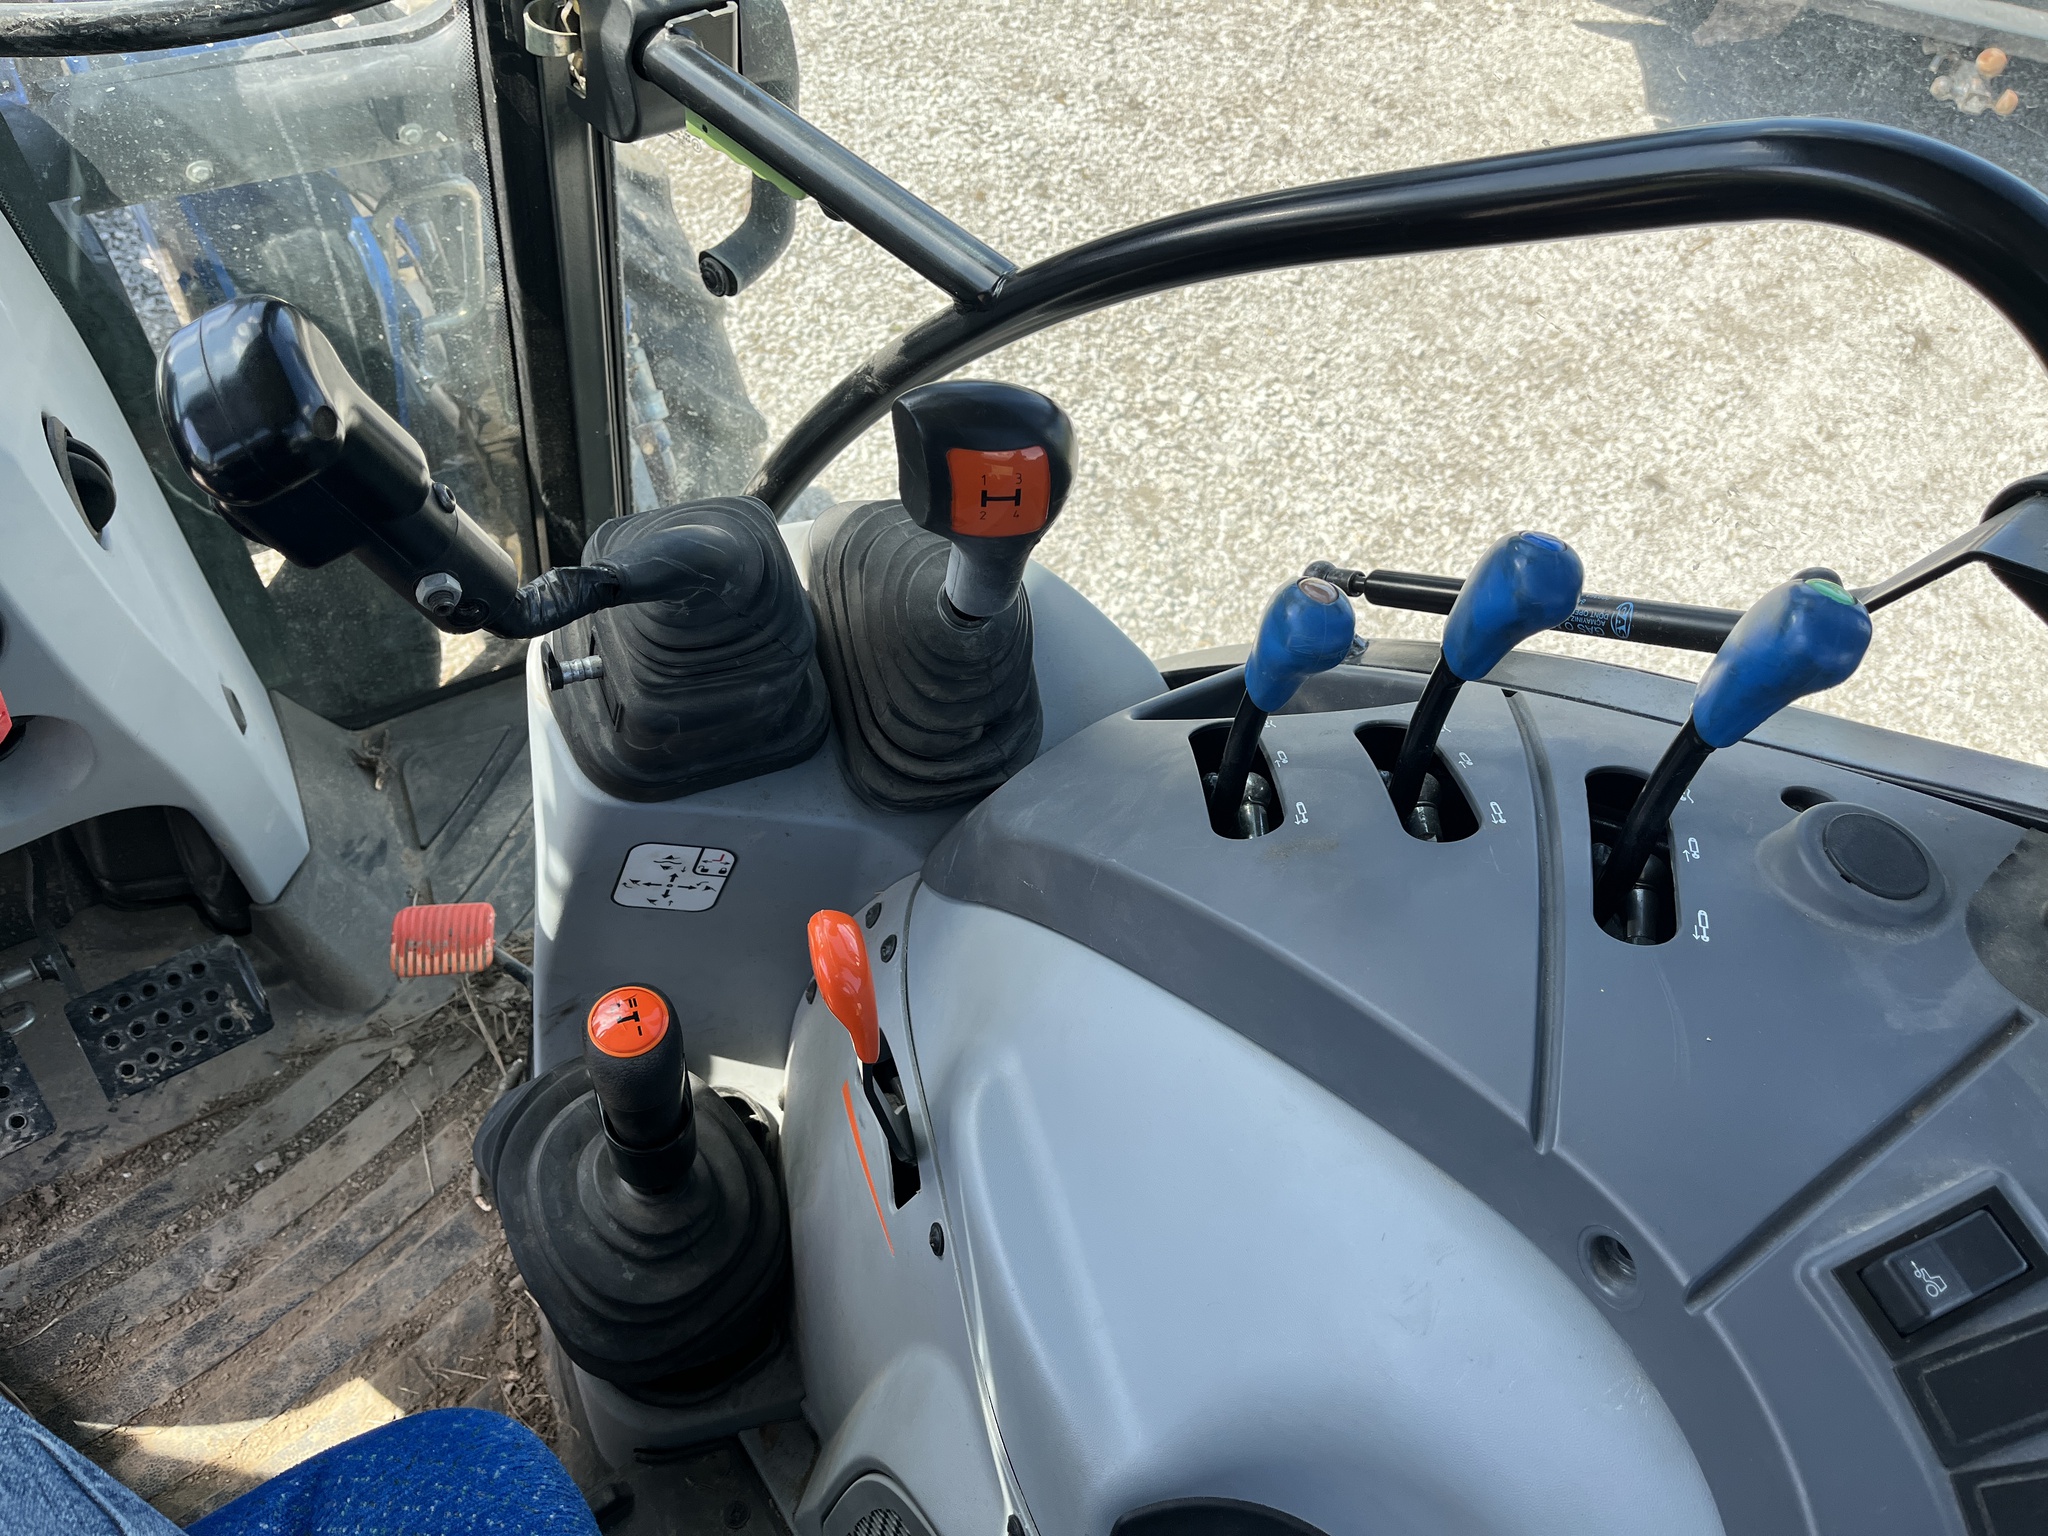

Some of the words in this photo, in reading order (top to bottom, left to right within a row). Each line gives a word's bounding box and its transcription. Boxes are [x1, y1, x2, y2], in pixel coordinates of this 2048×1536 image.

[981, 474, 986, 486] 1
[1015, 472, 1023, 485] 3
[979, 511, 987, 520] 2
[1013, 510, 1020, 518] 4
[1577, 623, 1605, 636] GAS
